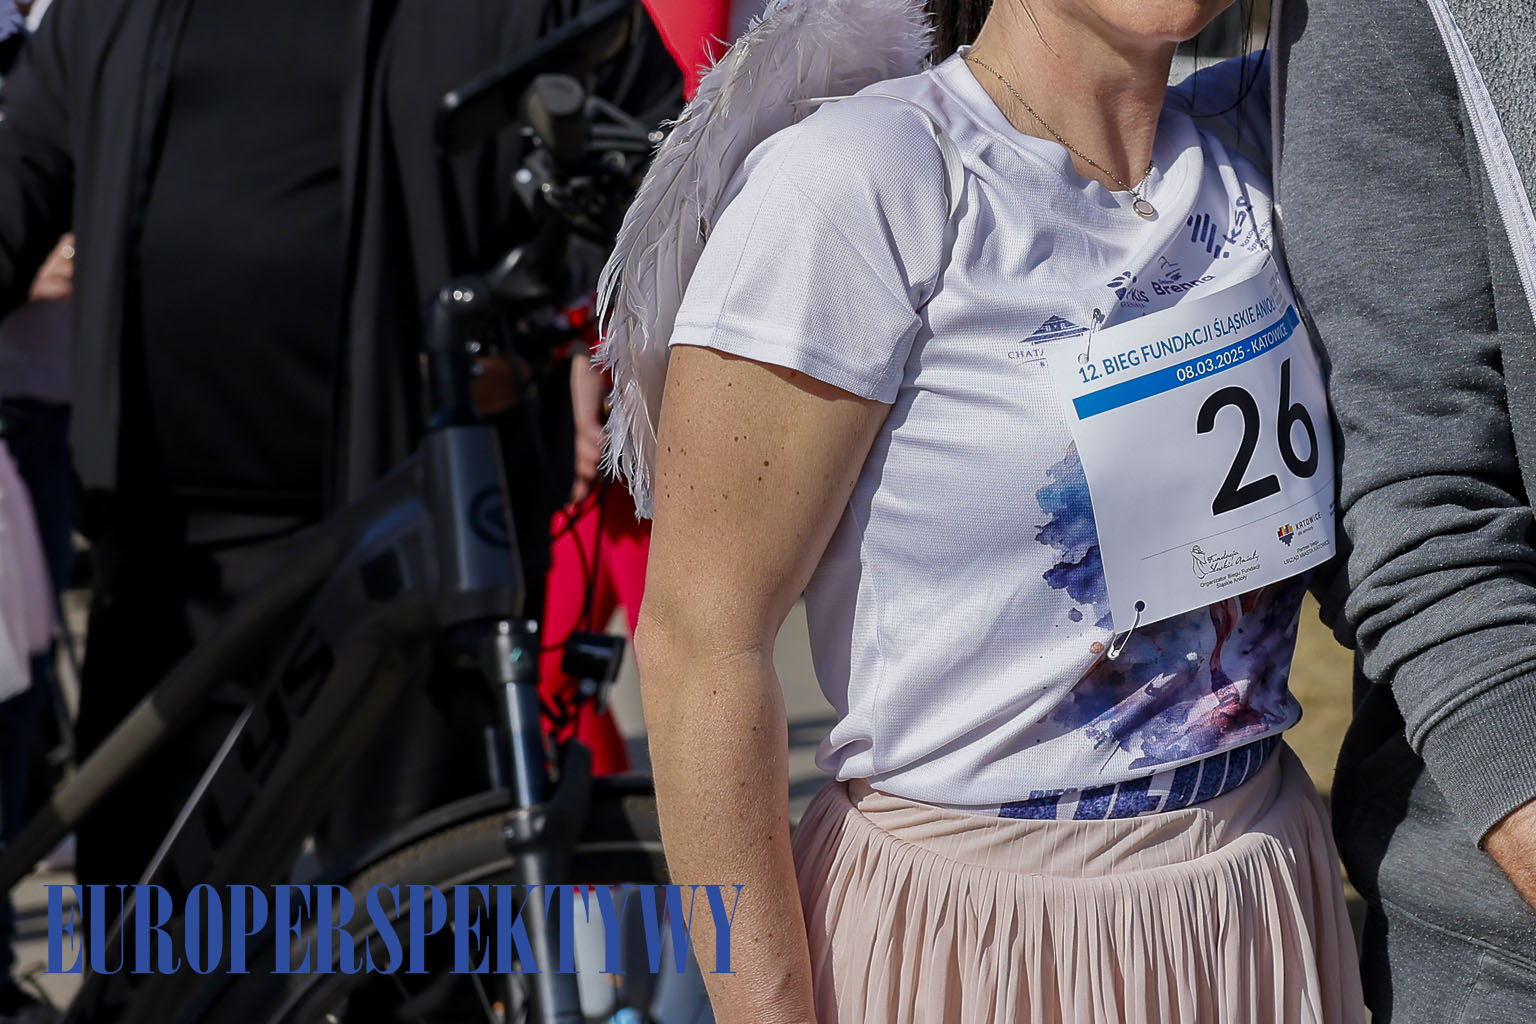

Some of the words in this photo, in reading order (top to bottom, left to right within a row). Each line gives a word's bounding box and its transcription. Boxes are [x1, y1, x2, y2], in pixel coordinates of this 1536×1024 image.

[1151, 275, 1216, 296] Brenna
[1078, 363, 1103, 384] 12.
[1102, 349, 1141, 375] BIEG
[1140, 324, 1213, 363] FUNDACJI
[1213, 306, 1257, 338] ŚLĄSKIE
[1176, 345, 1246, 382] 08.03.2025
[1250, 322, 1288, 354] KATOWICE
[1195, 356, 1319, 517] 26
